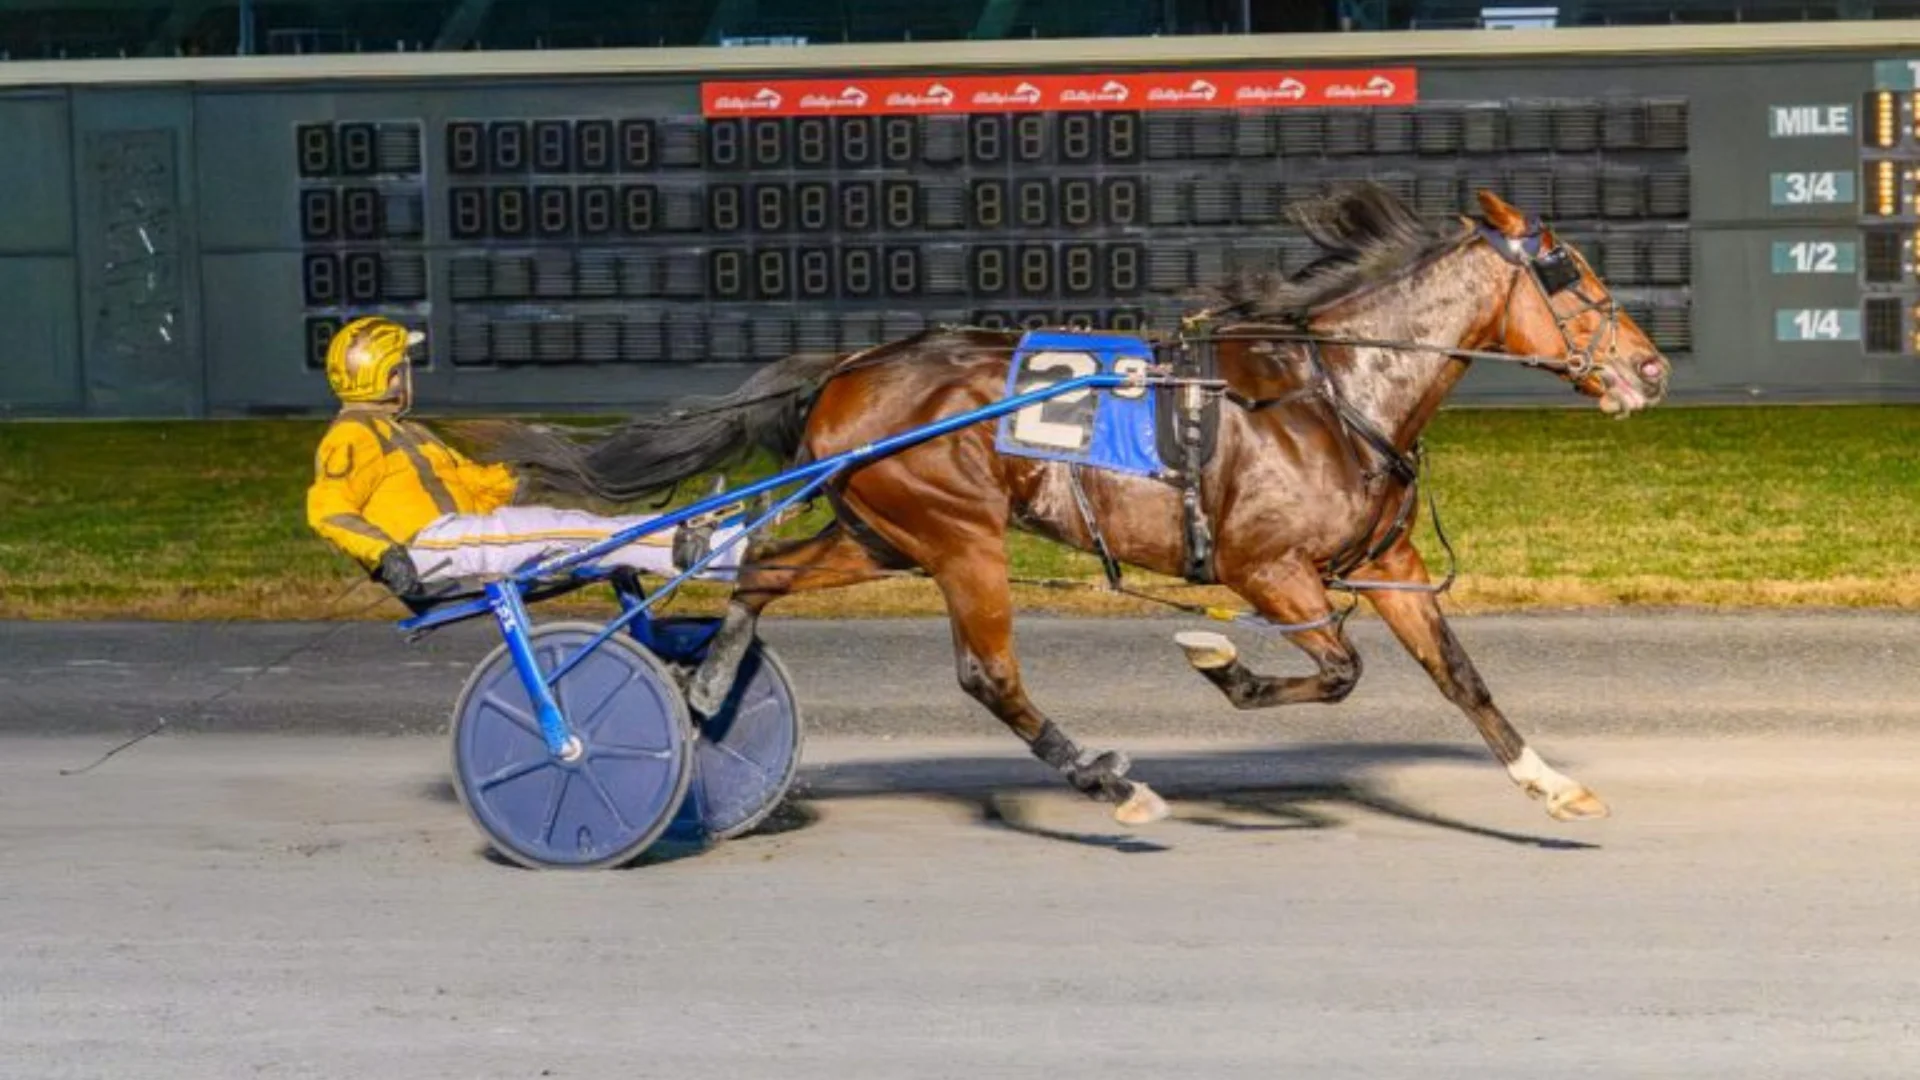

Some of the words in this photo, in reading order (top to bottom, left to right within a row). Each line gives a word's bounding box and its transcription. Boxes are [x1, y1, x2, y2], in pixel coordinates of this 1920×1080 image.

[1775, 106, 1849, 136] MILE
[1785, 172, 1837, 203] 3/4
[1789, 242, 1838, 272] 1/2
[1793, 309, 1841, 339] 1/4
[1014, 352, 1097, 449] 2
